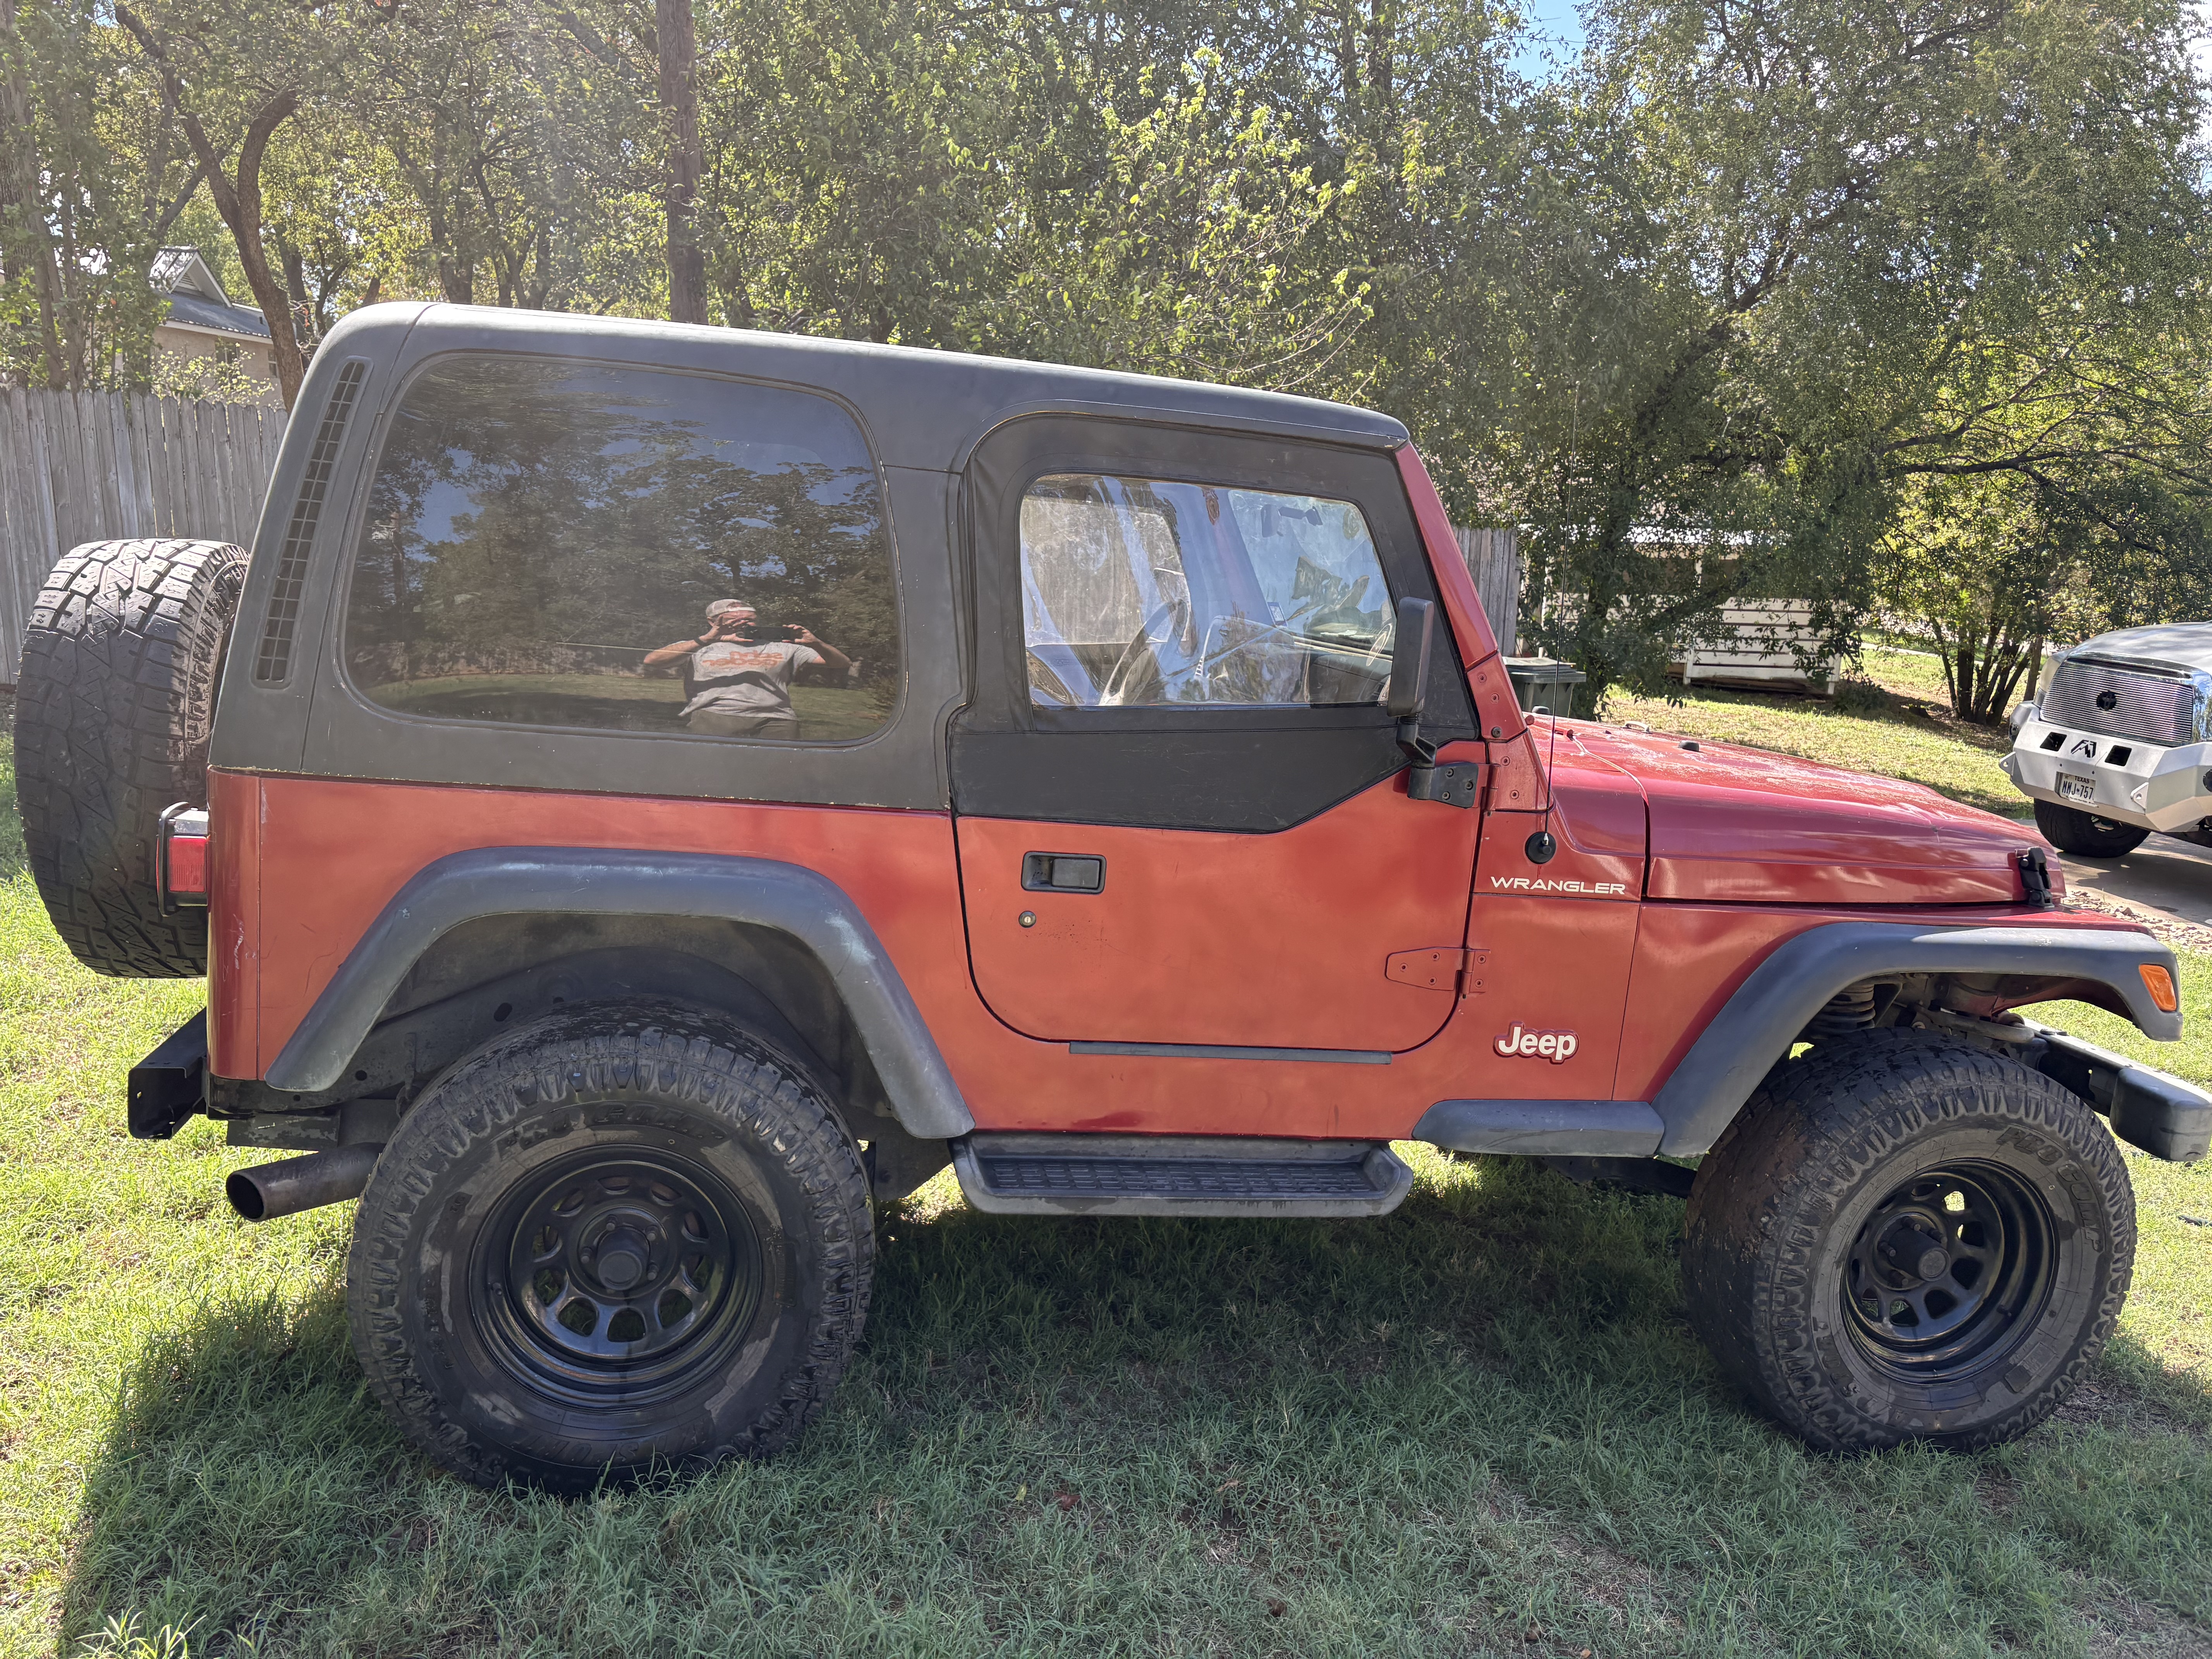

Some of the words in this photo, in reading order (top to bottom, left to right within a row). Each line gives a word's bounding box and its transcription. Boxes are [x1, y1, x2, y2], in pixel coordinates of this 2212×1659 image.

[2075, 776, 2090, 784] TEXAS
[1490, 876, 1626, 895] WRANGLER
[1498, 1027, 1576, 1060] Jeep
